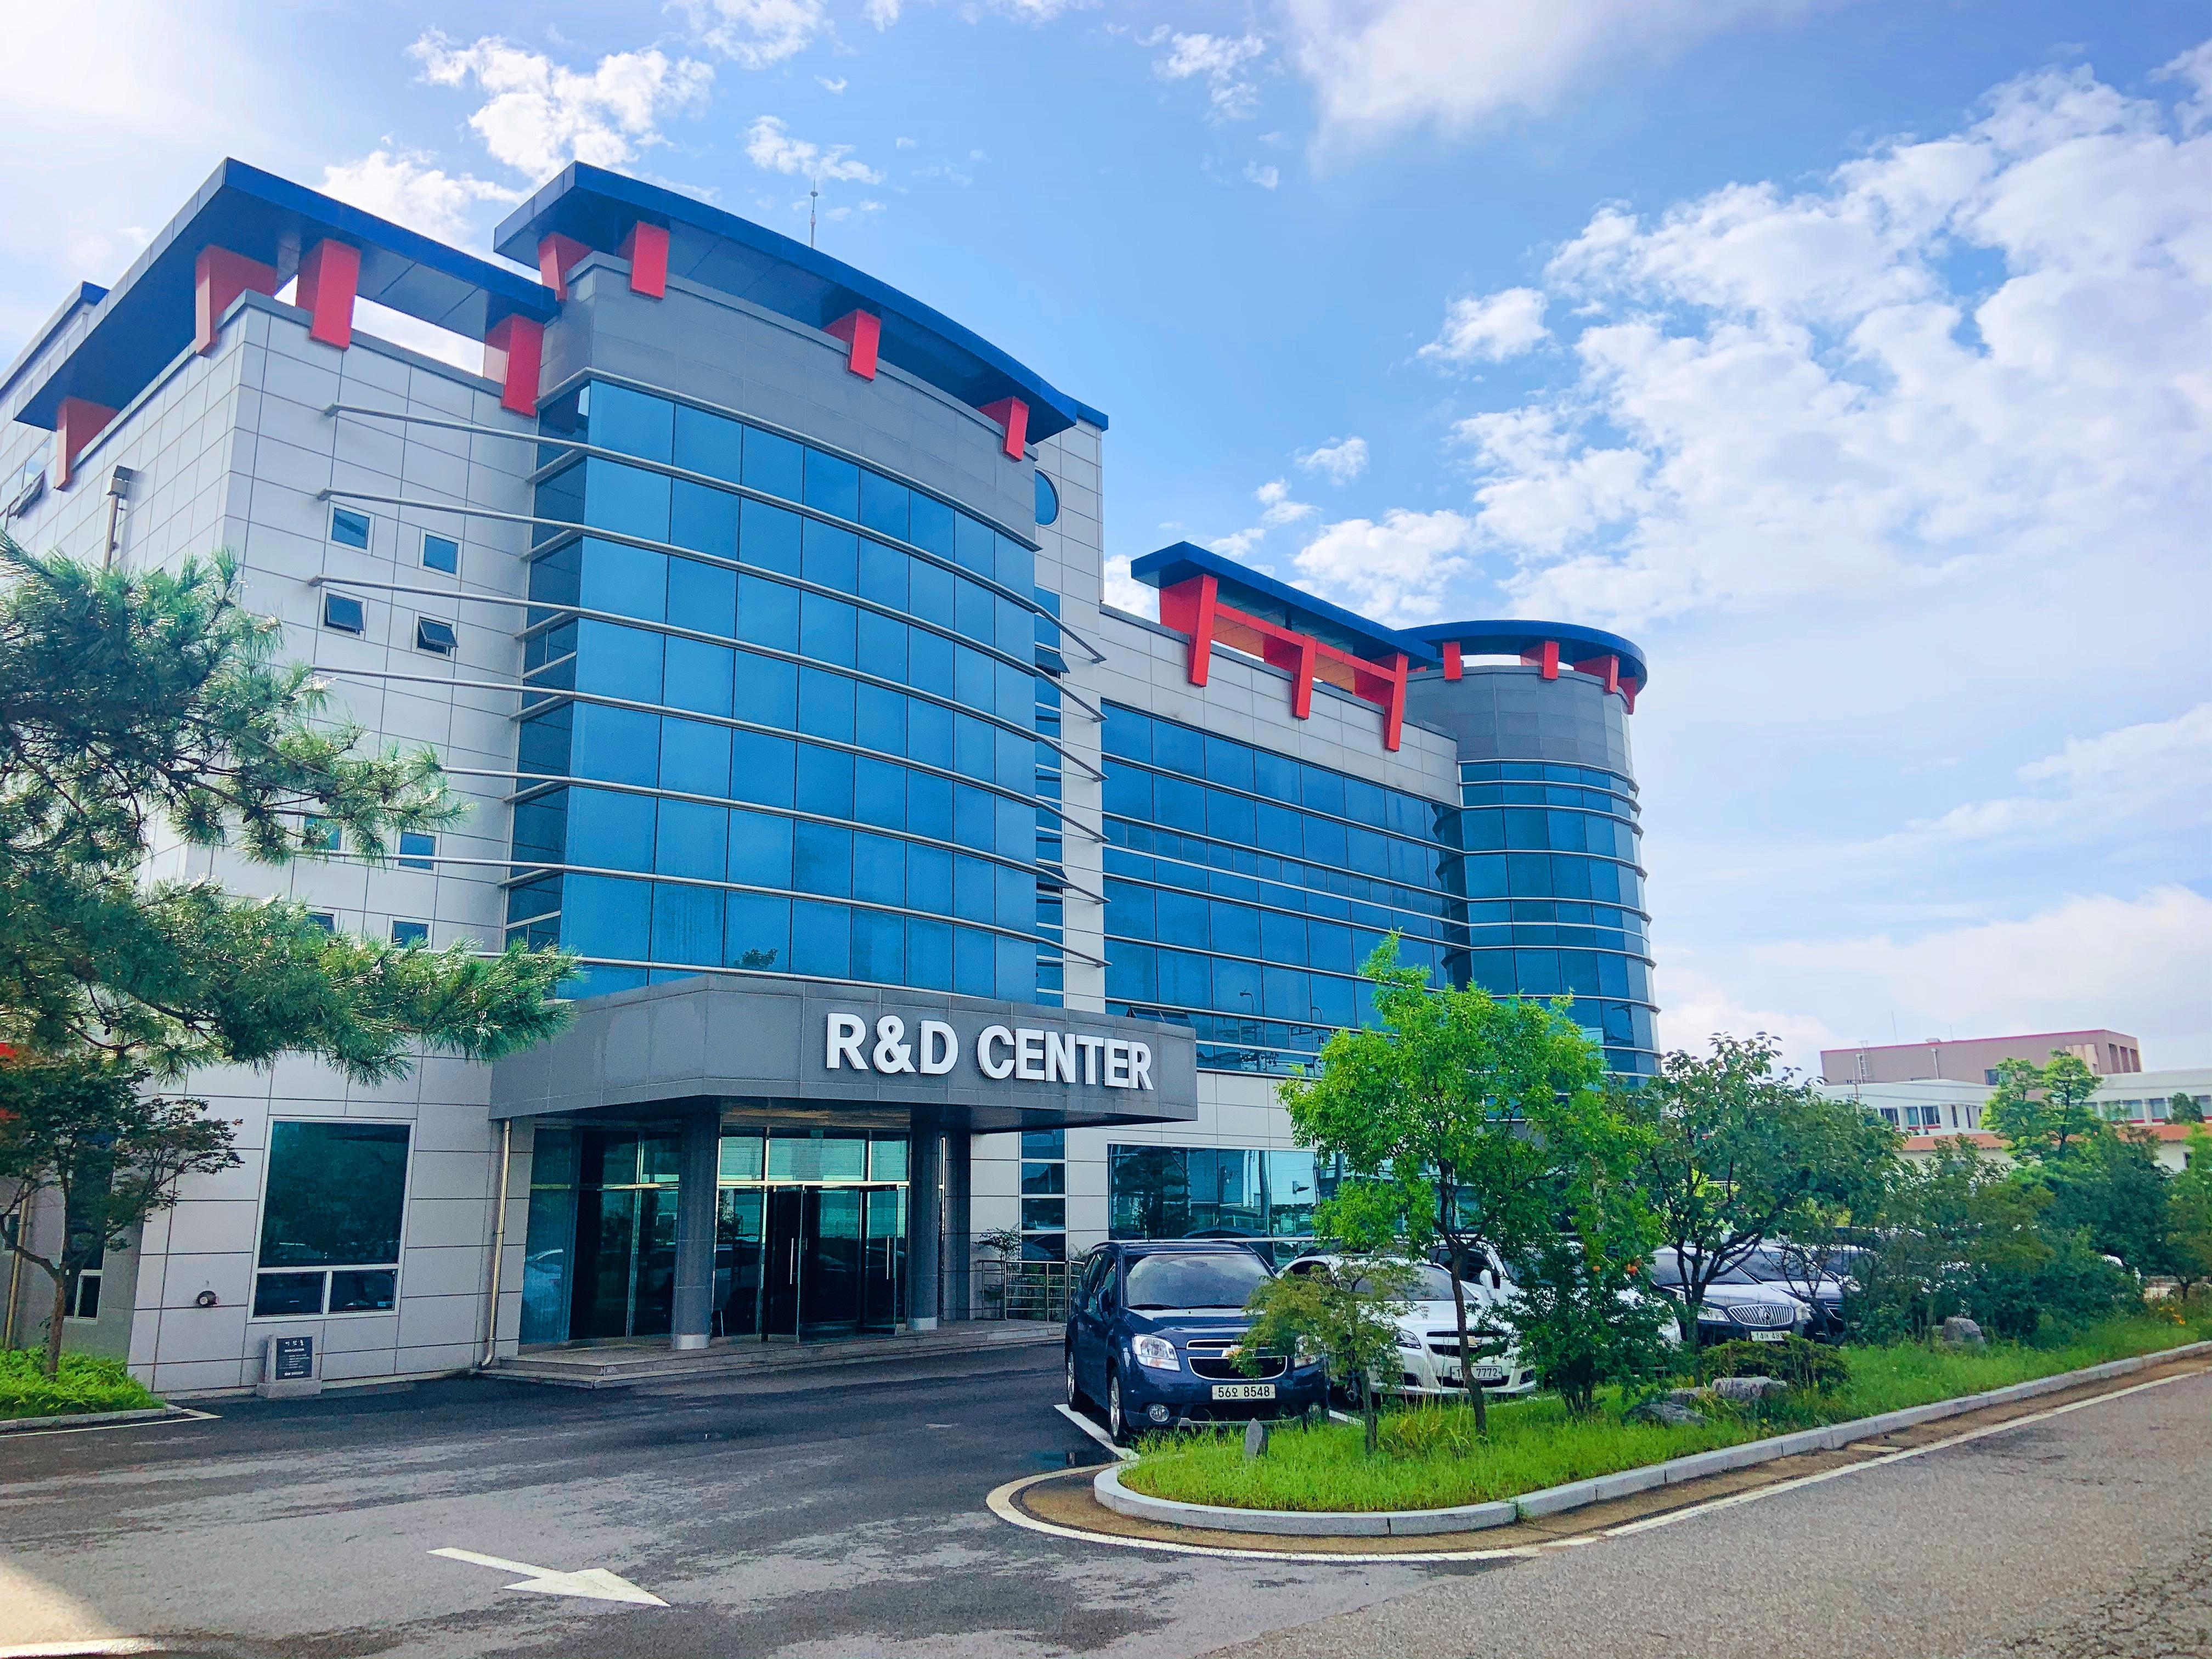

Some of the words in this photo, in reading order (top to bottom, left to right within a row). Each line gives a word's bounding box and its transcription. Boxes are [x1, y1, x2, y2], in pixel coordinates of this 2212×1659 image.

[826, 1013, 958, 1075] R&D
[977, 1024, 1154, 1090] CENTER
[1476, 1368, 1498, 1377] 7772
[1218, 1386, 1238, 1397] 56오
[1243, 1386, 1270, 1397] 8548
